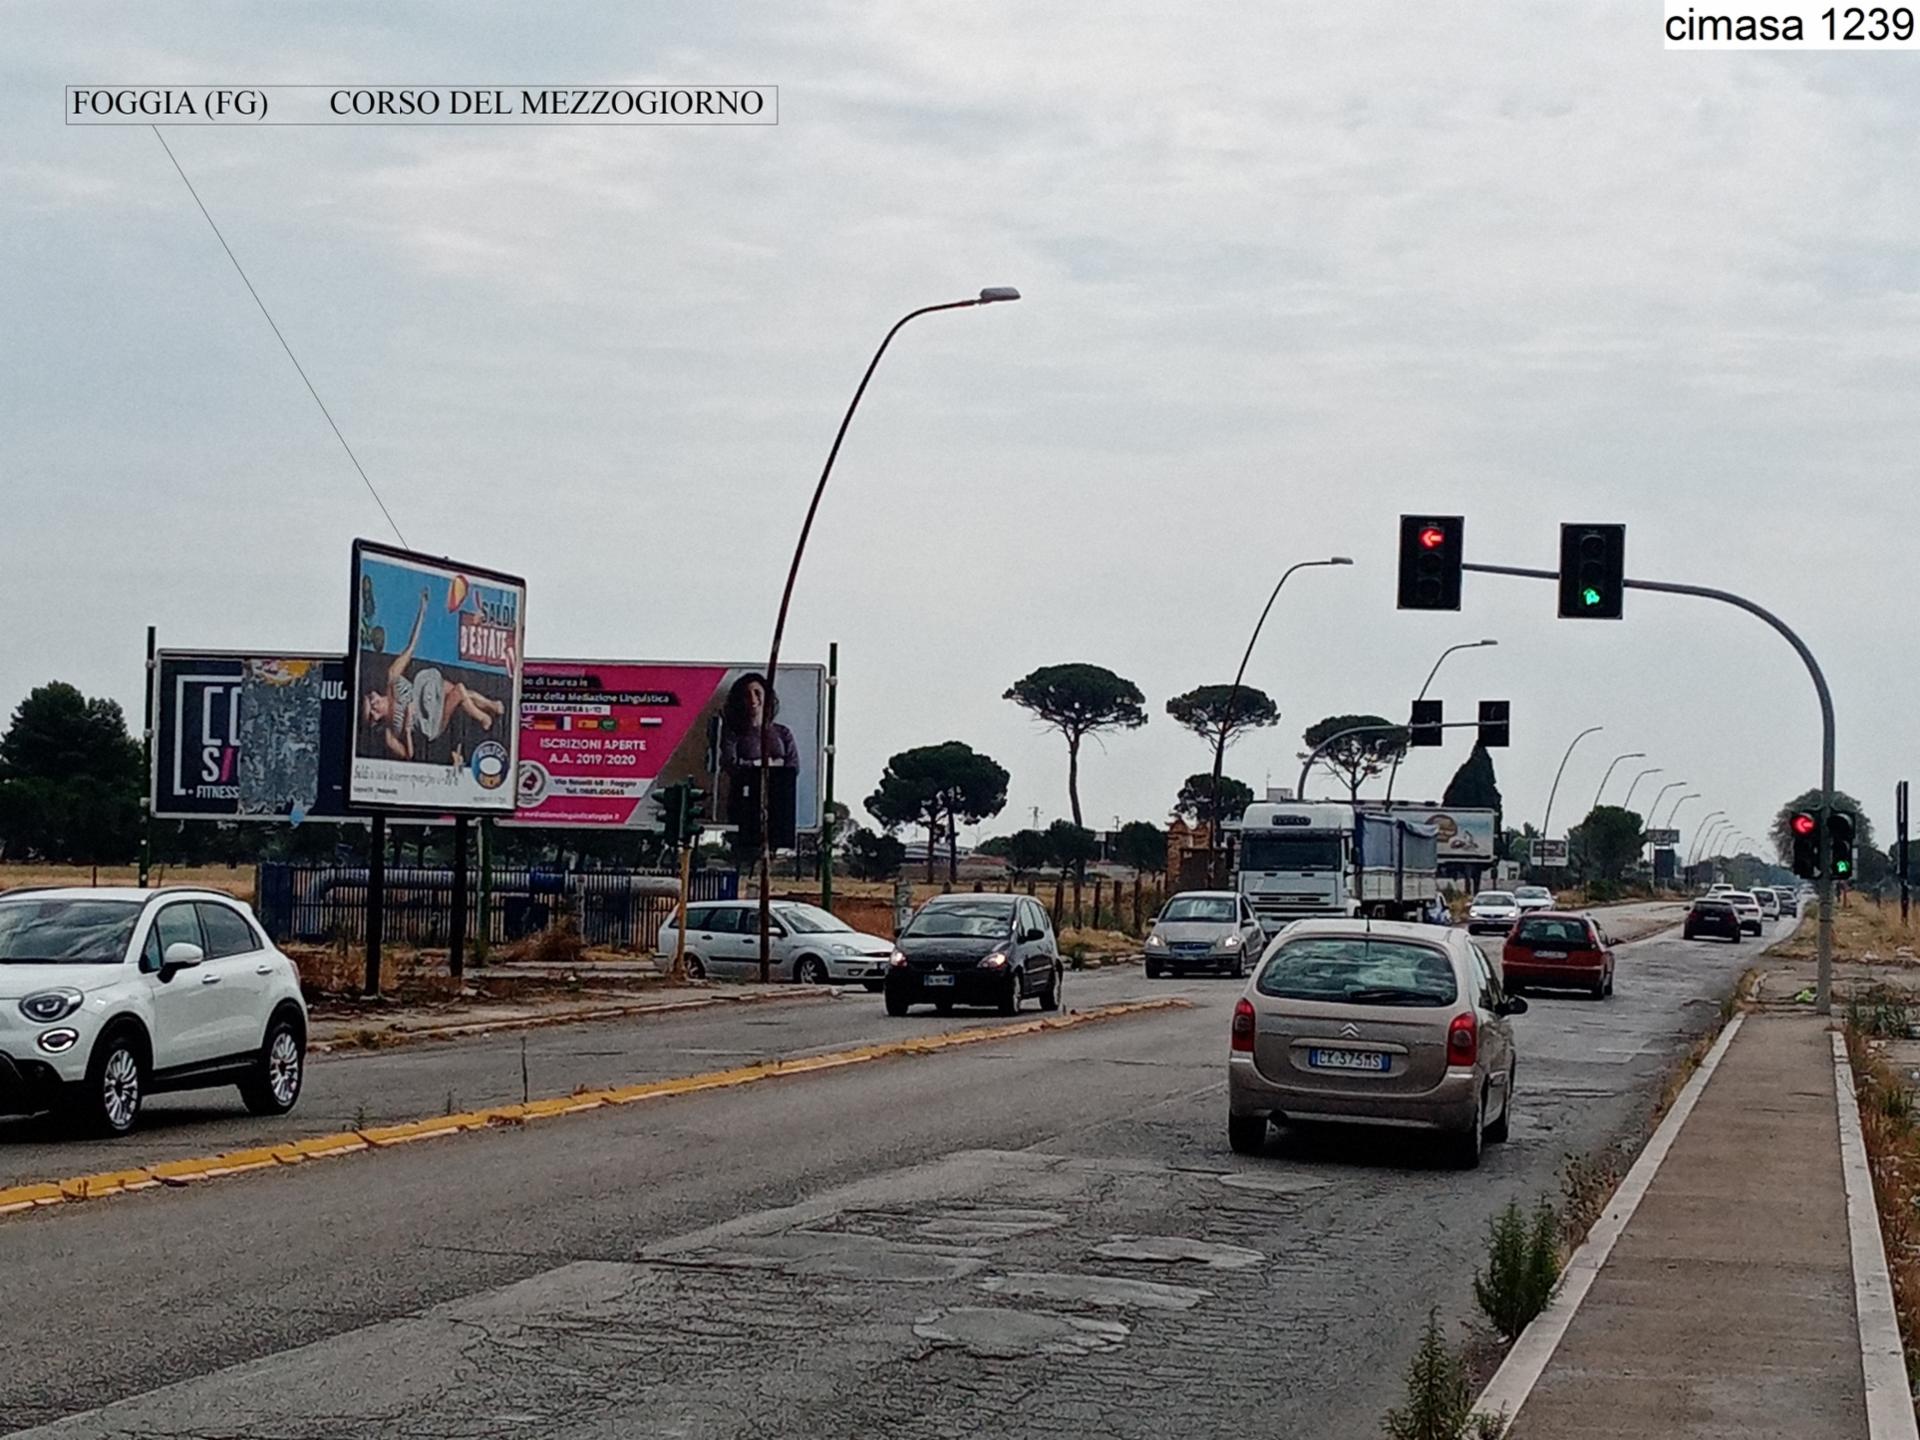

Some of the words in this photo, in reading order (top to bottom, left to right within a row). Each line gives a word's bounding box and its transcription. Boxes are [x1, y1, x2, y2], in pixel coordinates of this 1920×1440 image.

[546, 677, 578, 687] Laurea
[619, 693, 670, 705] Linguistica
[551, 704, 583, 713] LAUREA
[540, 738, 602, 750] ISCRIZIONI
[603, 739, 647, 751] APERTE
[548, 753, 574, 764] A.A.
